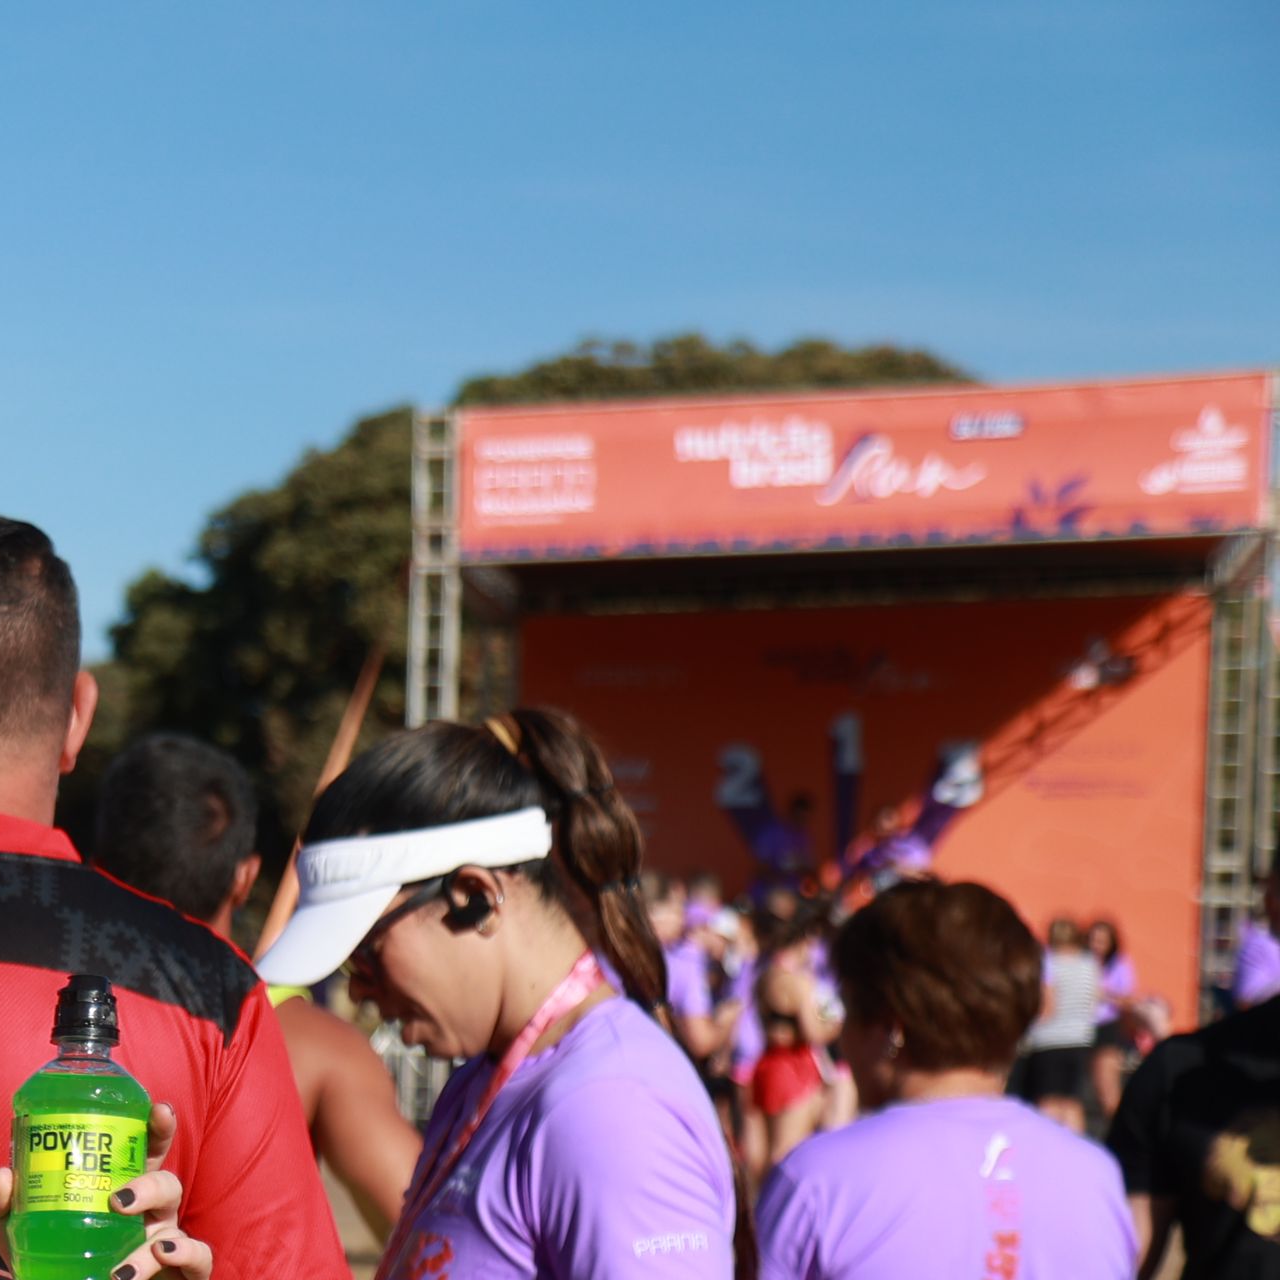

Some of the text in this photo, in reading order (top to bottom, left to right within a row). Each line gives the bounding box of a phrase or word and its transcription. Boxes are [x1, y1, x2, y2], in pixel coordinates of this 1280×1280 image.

[30, 1131, 113, 1153] POWER
[64, 1172, 112, 1192] SOUR
[63, 1192, 81, 1203] 500
[82, 1194, 94, 1203] ml
